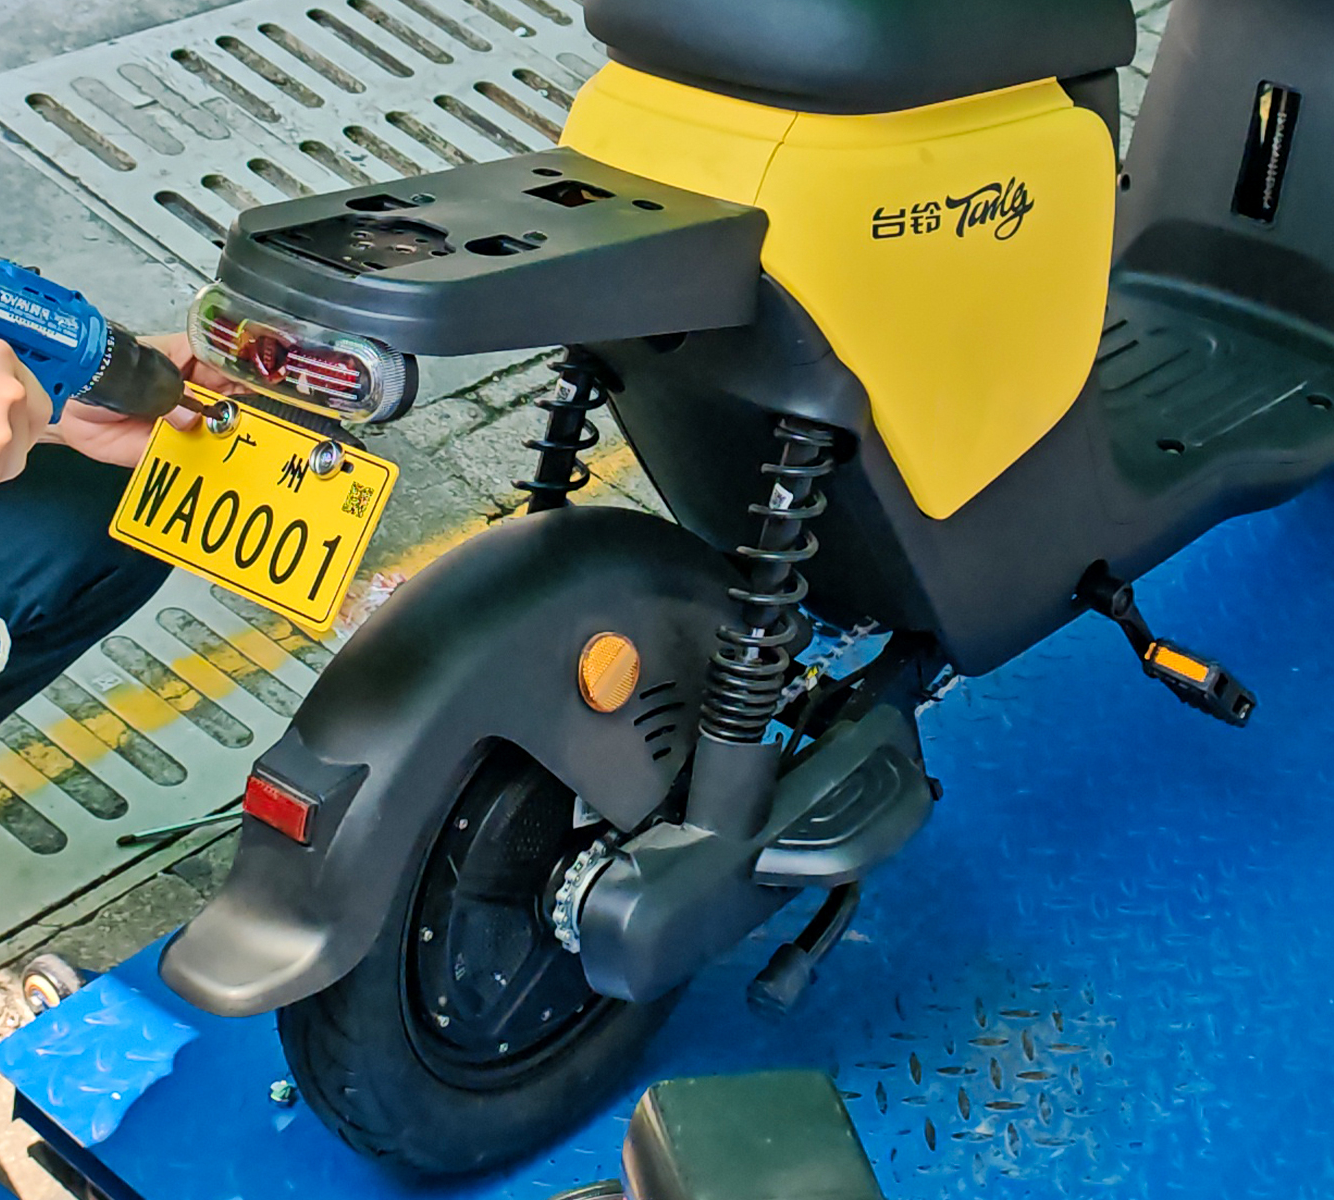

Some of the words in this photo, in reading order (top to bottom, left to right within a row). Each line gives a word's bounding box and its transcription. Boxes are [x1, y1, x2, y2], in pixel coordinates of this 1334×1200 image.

[872, 201, 942, 240] 台铃
[222, 433, 310, 494] 广州
[133, 457, 342, 601] WA0001
